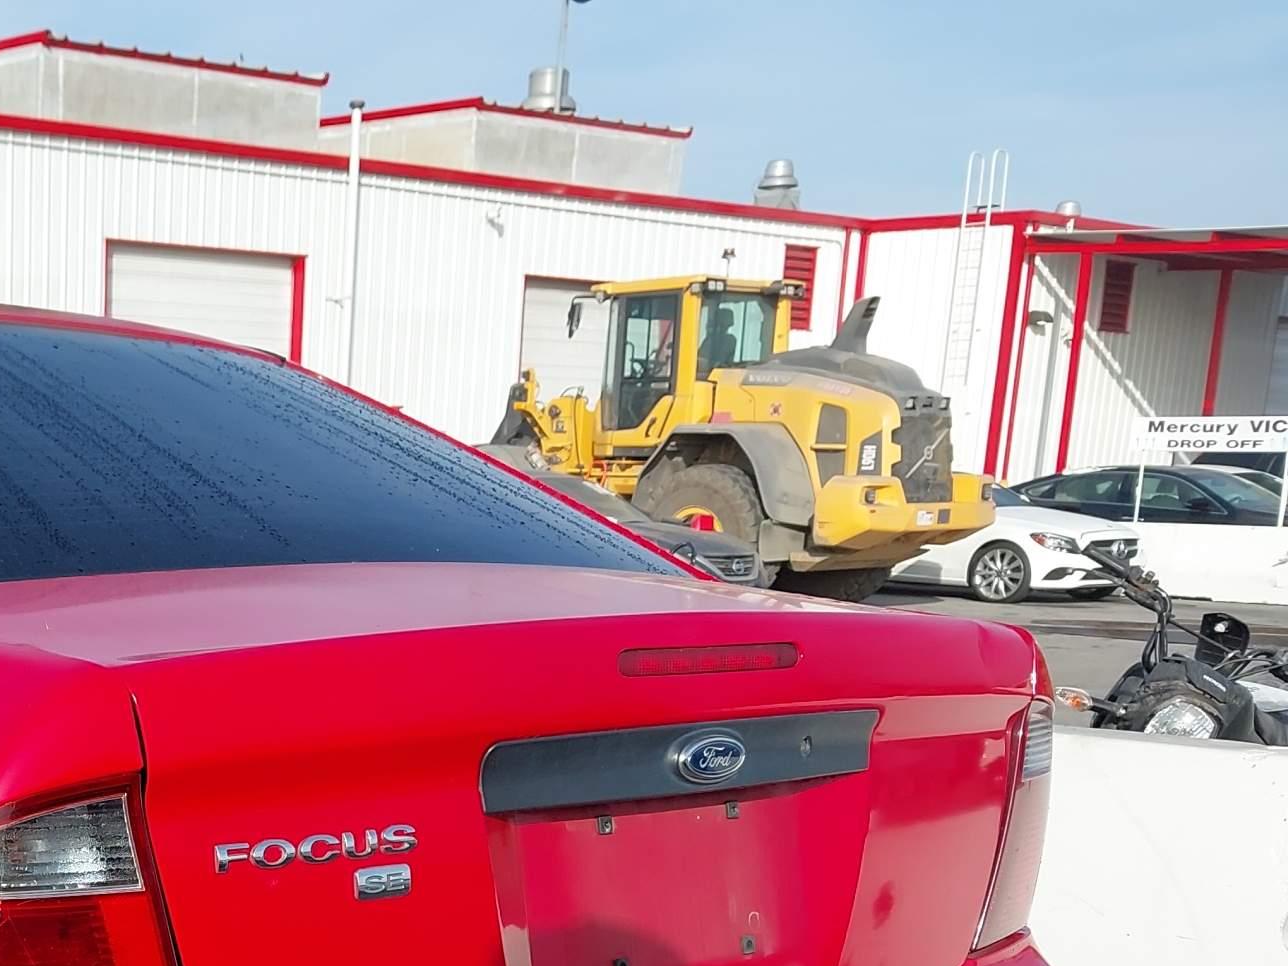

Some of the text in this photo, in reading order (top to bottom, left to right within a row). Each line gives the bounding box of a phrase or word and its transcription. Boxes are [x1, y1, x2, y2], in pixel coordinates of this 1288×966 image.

[1148, 420, 1288, 436] Mercury VIC
[1167, 439, 1265, 449] DROP OFF
[699, 745, 734, 769] Ford
[213, 824, 418, 874] FOCUS
[360, 871, 411, 895] SE
